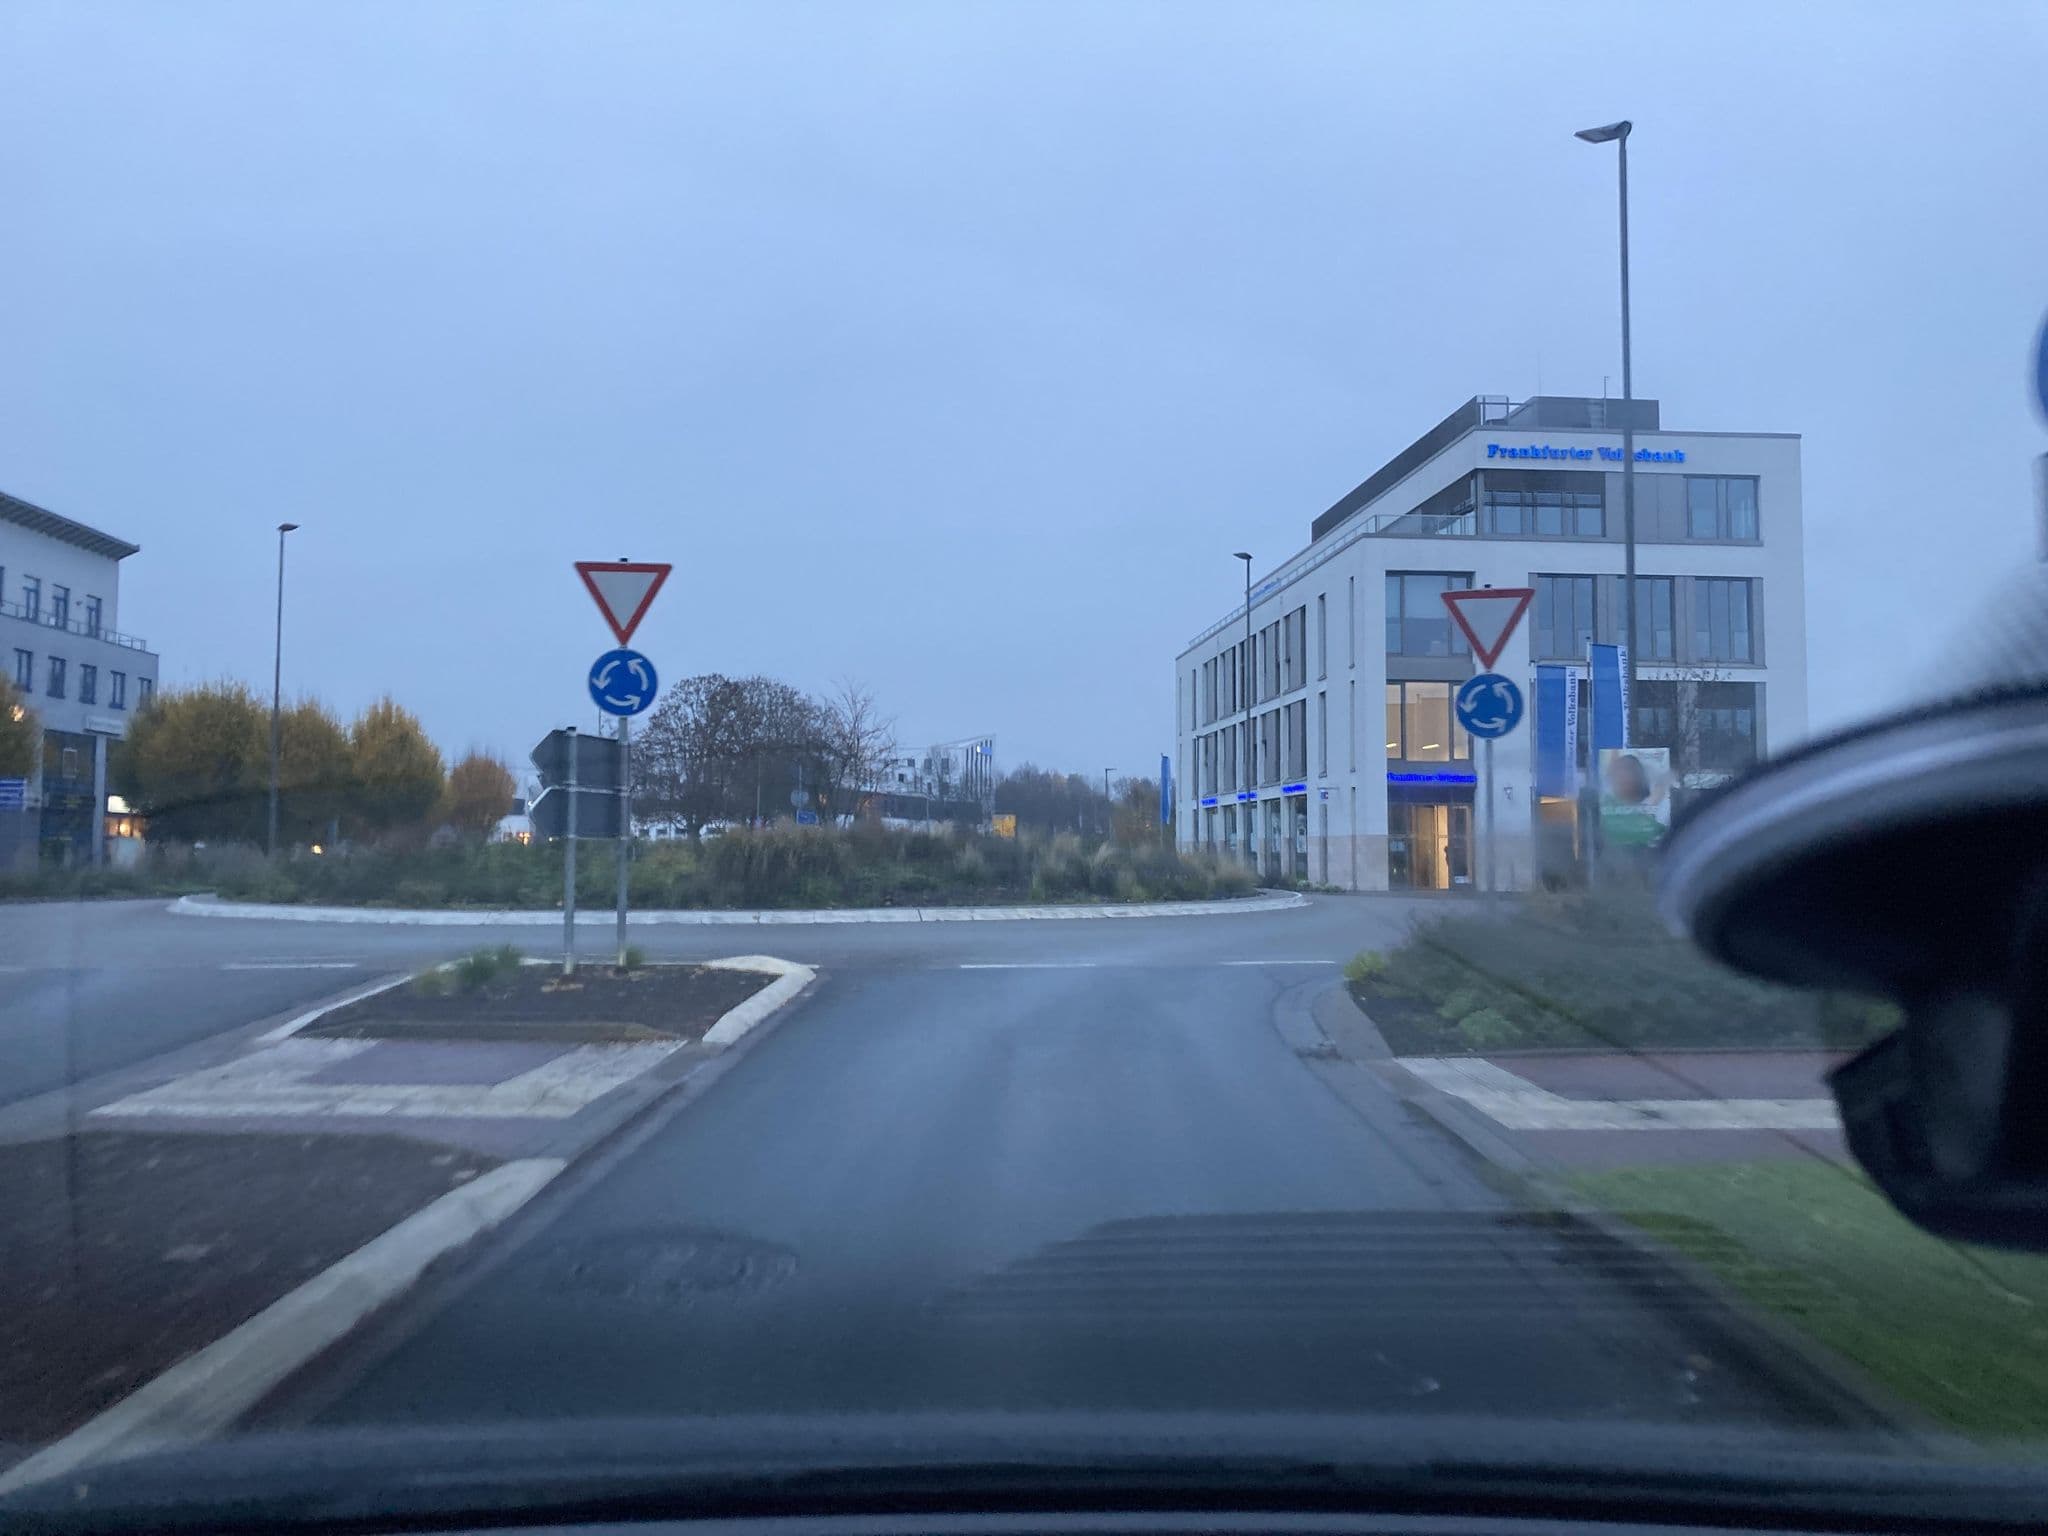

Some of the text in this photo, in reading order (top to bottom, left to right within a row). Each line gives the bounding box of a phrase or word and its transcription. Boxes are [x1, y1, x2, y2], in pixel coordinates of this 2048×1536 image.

[1487, 444, 1686, 463] Frankfurter Volsbank
[1567, 669, 1577, 727] Volksbank
